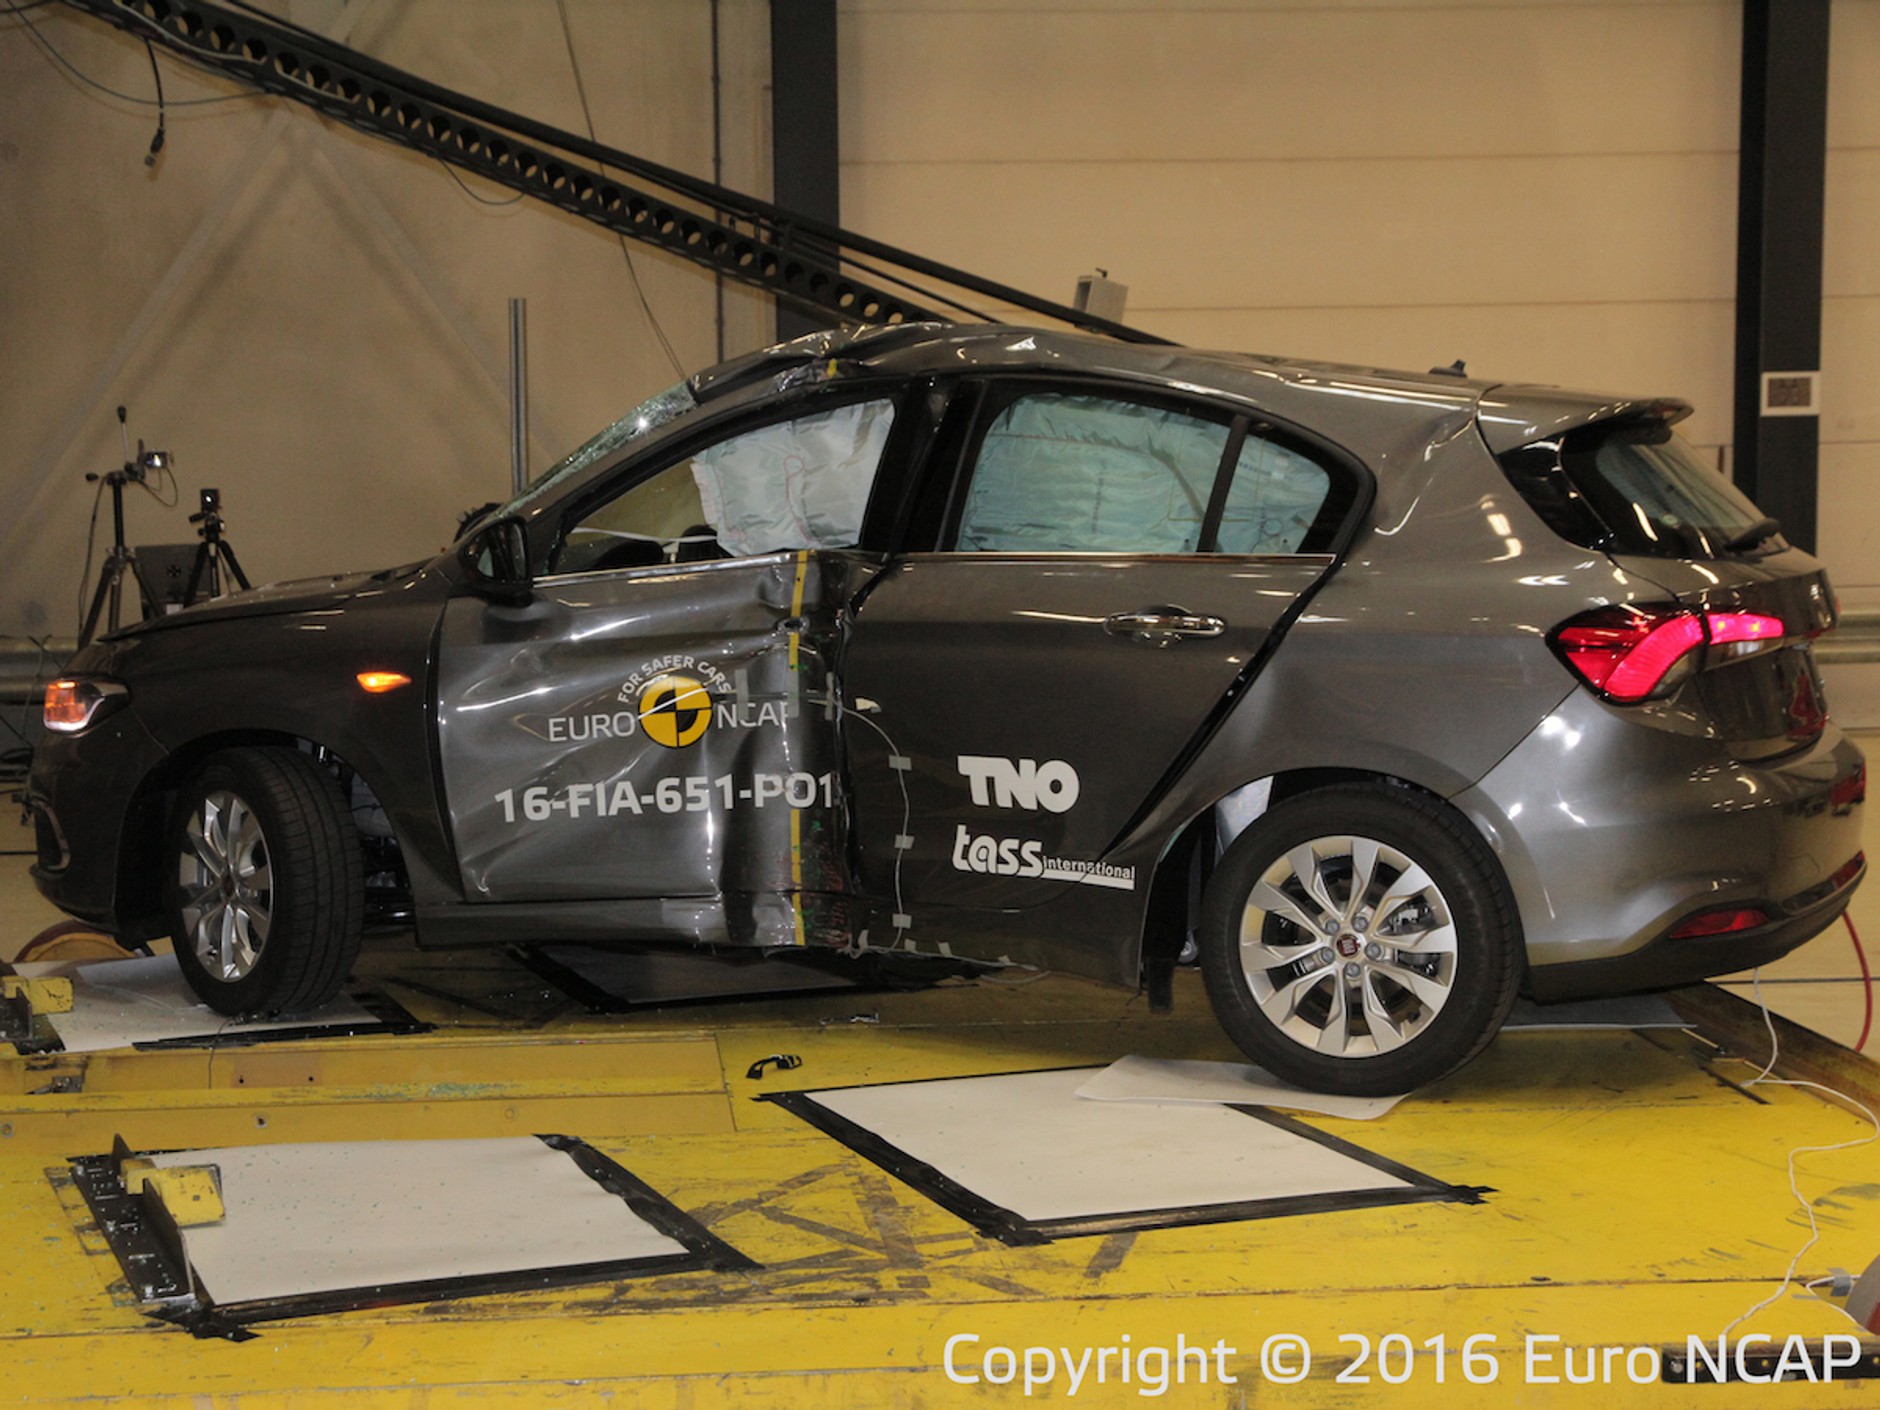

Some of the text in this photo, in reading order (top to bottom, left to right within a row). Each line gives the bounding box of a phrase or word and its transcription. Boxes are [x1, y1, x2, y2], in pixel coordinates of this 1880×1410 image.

[617, 655, 732, 703] FOR SAFER CARS
[549, 711, 636, 742] EURO
[957, 755, 1080, 813] TNO
[1043, 855, 1135, 879] international
